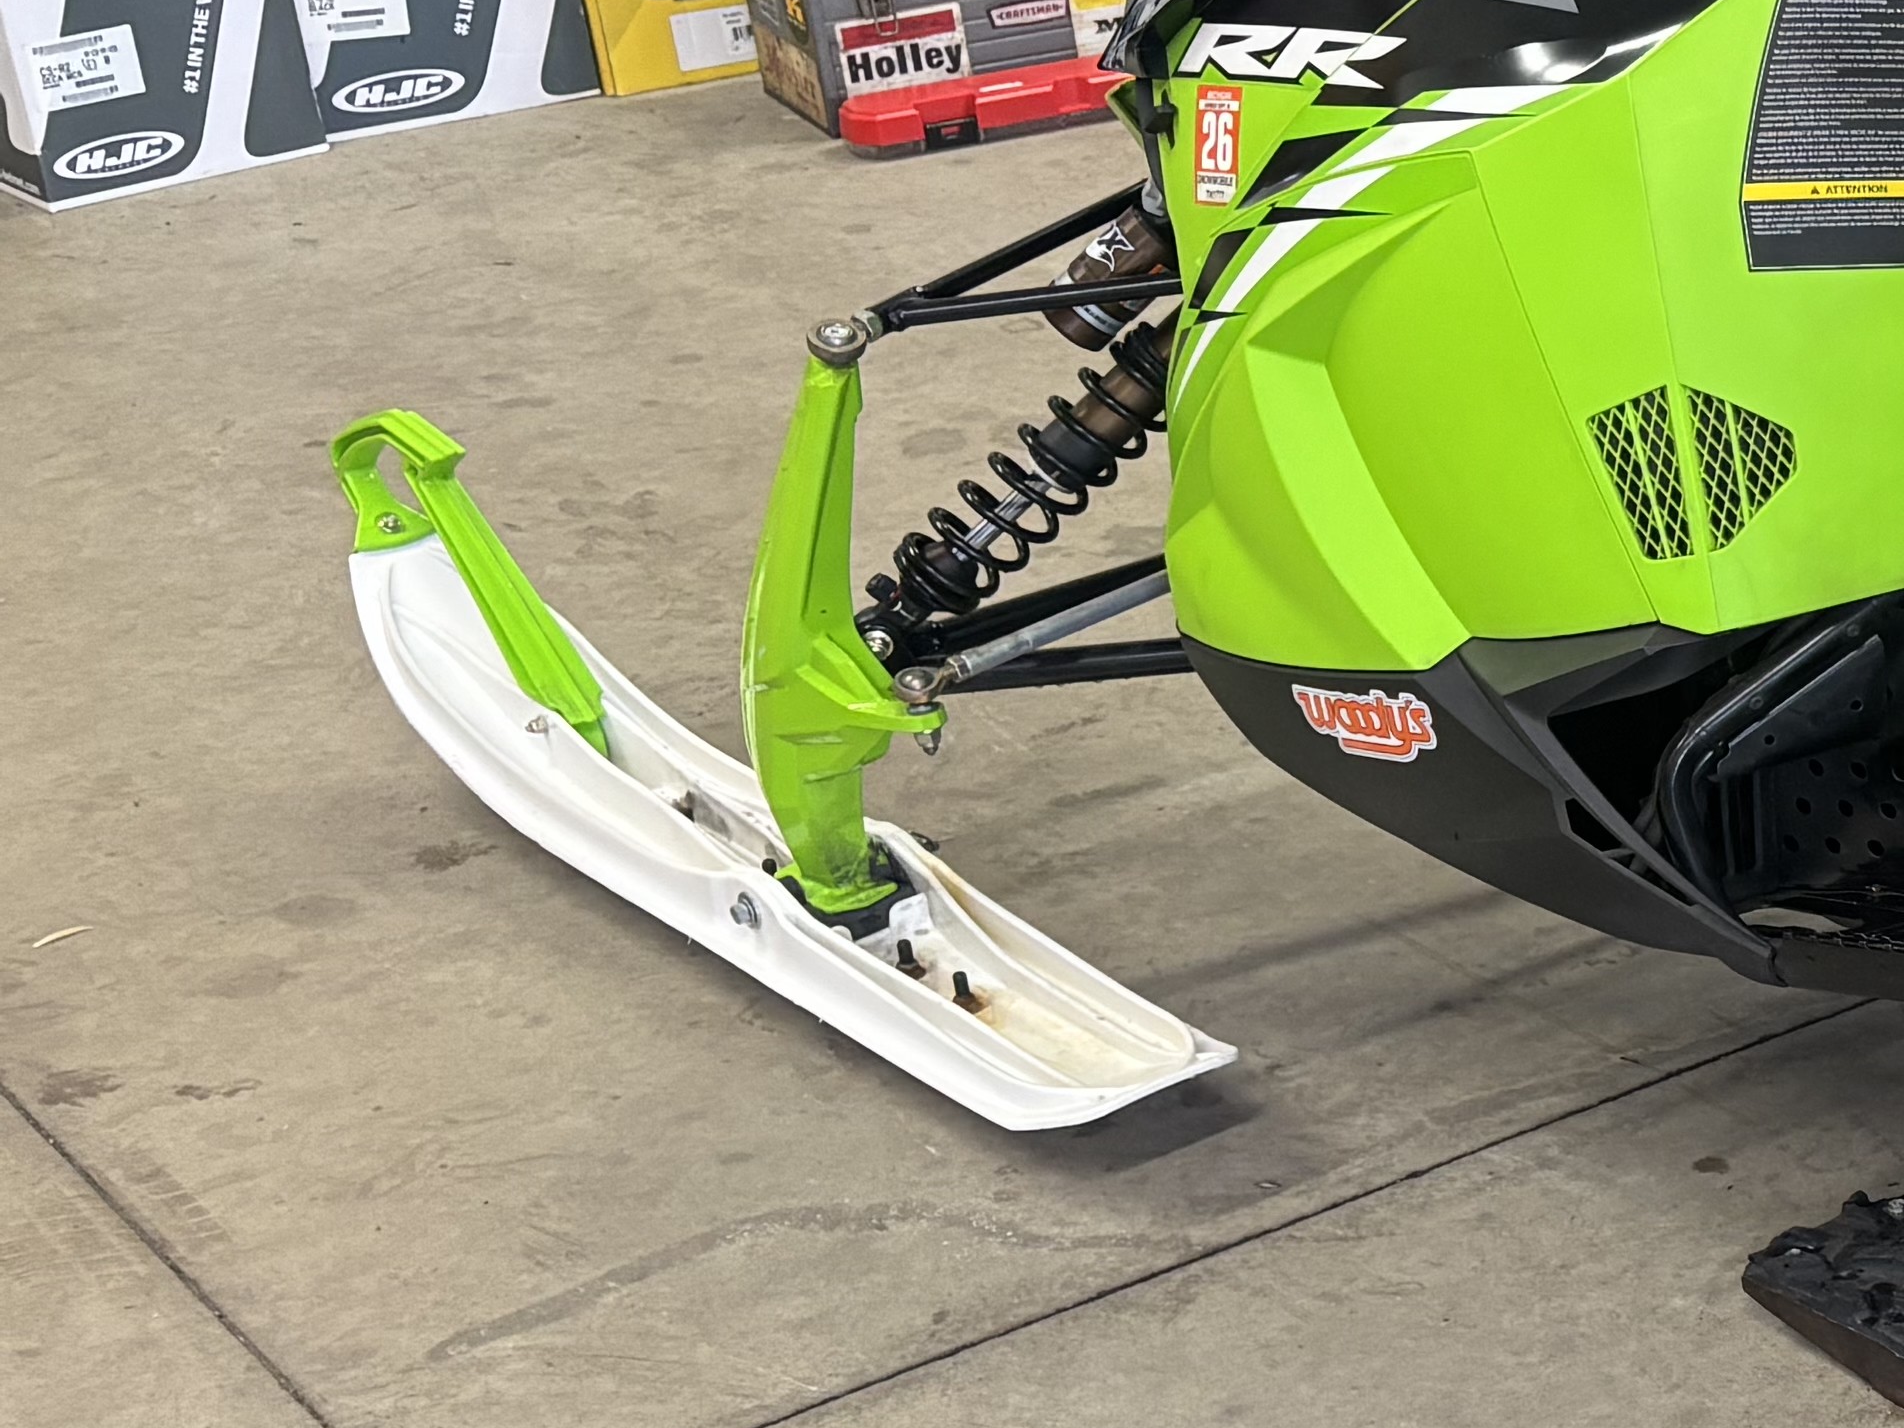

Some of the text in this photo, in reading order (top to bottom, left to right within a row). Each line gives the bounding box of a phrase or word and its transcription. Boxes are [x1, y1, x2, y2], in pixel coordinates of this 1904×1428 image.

[190, 7, 210, 44] THE
[454, 12, 473, 36] #1
[999, 3, 1060, 21] CRAFTSMAN
[186, 46, 205, 67] IN
[846, 42, 963, 84] Holley
[1178, 23, 1407, 90] RR
[183, 69, 202, 93] #1
[355, 74, 444, 108] HJC
[75, 137, 164, 174] HJC
[1201, 111, 1233, 172] 26
[1825, 184, 1889, 195] ATTENTION
